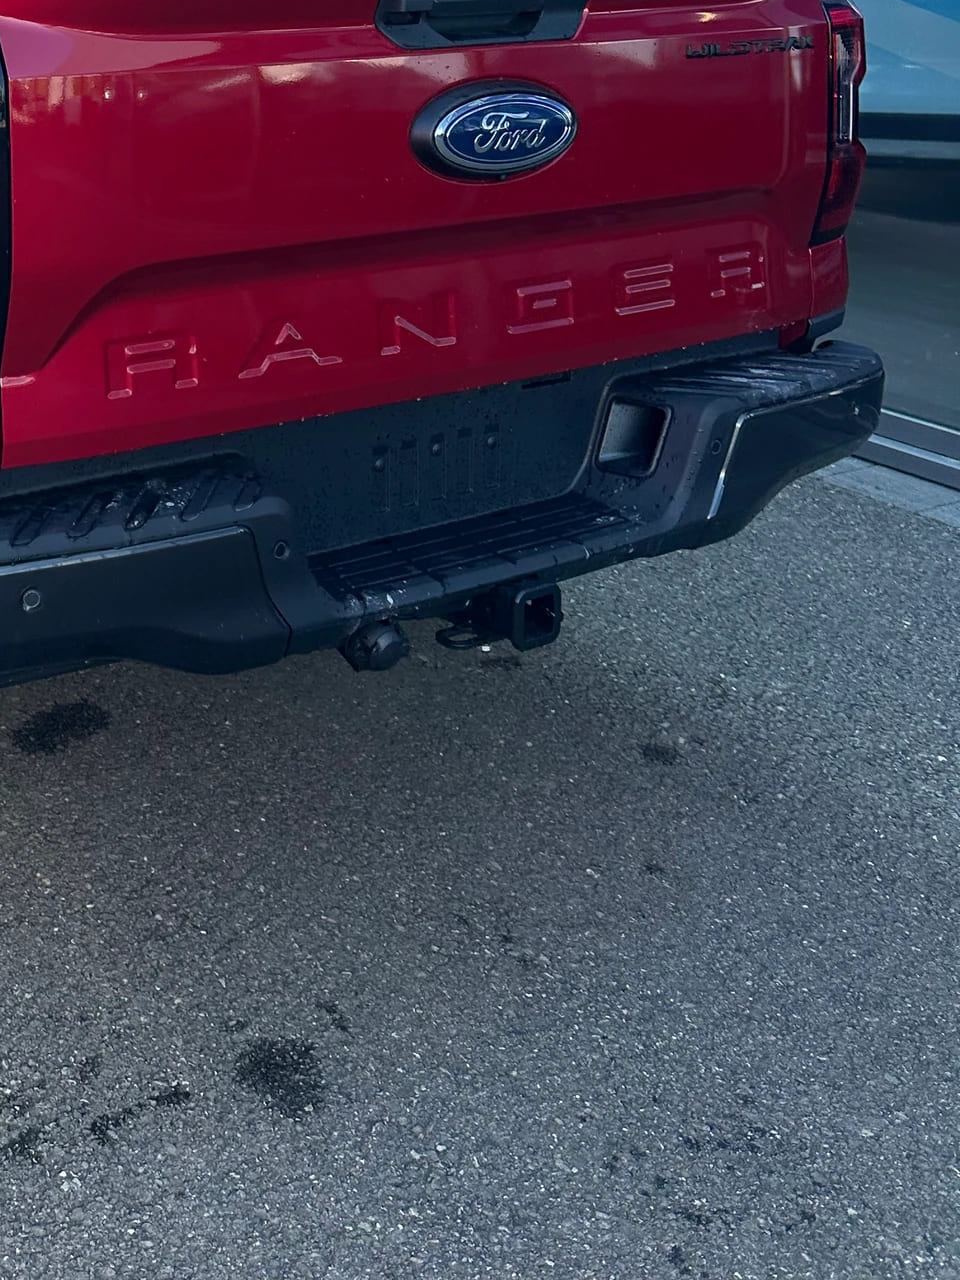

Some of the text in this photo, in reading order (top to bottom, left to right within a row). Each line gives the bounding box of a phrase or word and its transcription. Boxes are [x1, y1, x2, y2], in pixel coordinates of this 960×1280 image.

[685, 35, 814, 59] WILDTRAK
[473, 111, 547, 153] Ford
[104, 242, 766, 400] RANGER
